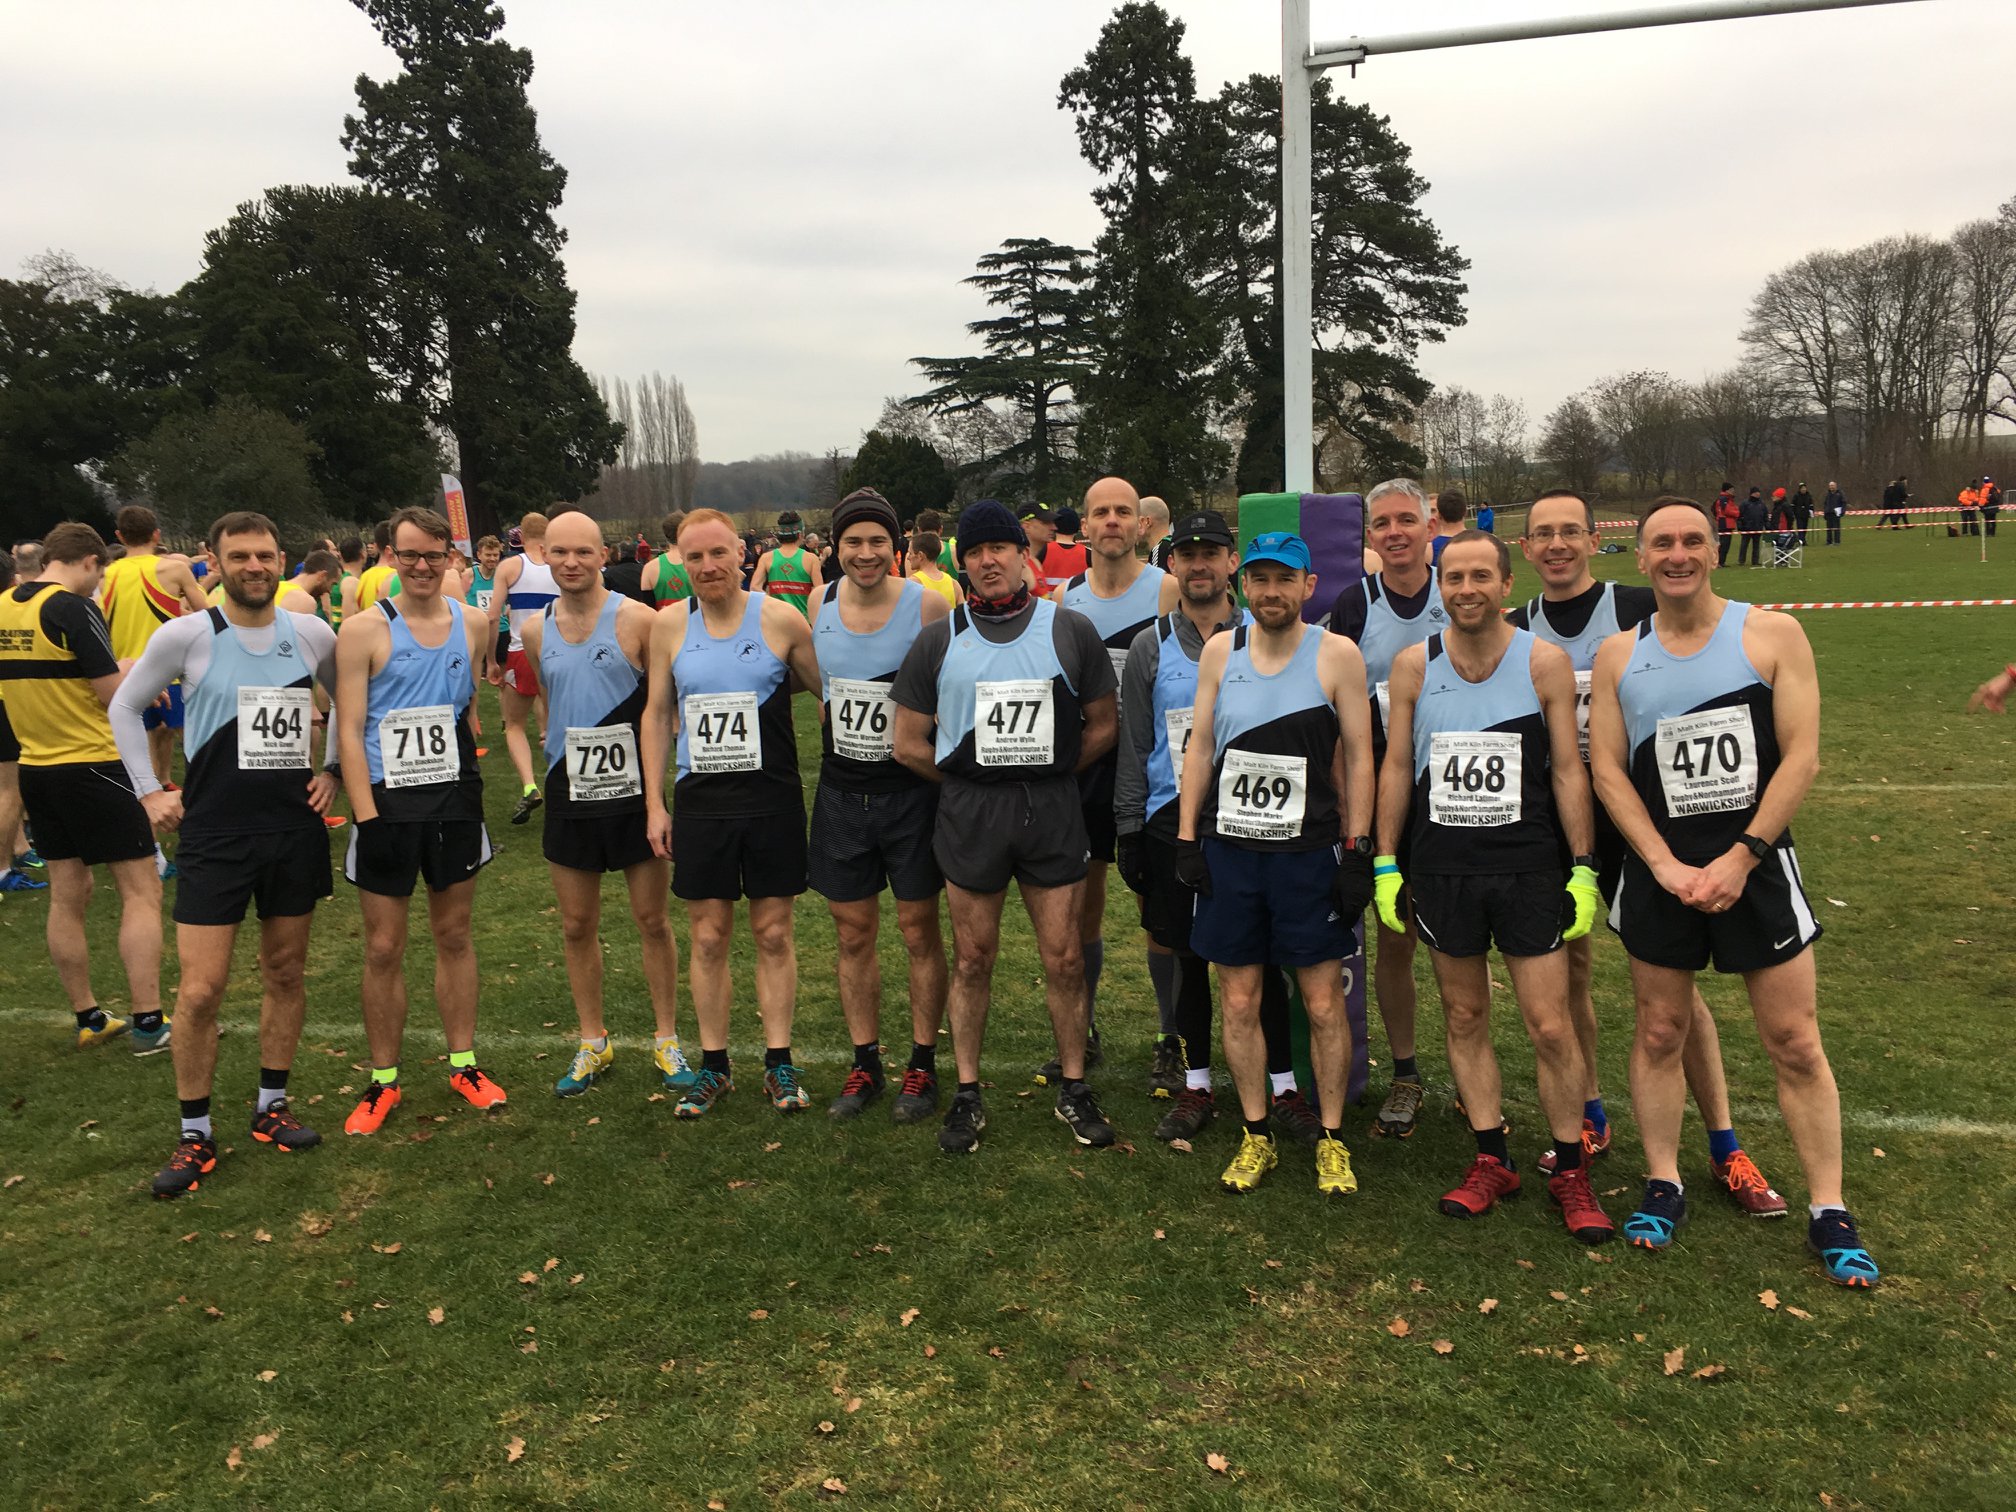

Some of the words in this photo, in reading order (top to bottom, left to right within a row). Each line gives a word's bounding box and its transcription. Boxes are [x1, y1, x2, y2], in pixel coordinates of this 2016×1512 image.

[252, 707, 302, 738] 464
[839, 699, 887, 733] 476
[987, 701, 1041, 734] 477
[698, 712, 747, 744] 474
[1677, 725, 1694, 733] Malt
[393, 725, 446, 758] 718
[577, 743, 625, 774] 720
[838, 746, 894, 760] WARWICKSHIRE
[983, 754, 1048, 764] WARWICKSHIRE
[1673, 733, 1741, 778] 470
[246, 759, 306, 767] WARWICKSHIRE
[696, 761, 756, 771] WARWICKSHIRE
[393, 772, 457, 786] WARWICKSHIRE
[1443, 755, 1505, 792] 468
[1684, 780, 1718, 789] Laurence
[1721, 775, 1740, 784] Scott
[576, 787, 636, 799] WARWICKSHIRE
[1232, 774, 1291, 810] 469
[1675, 794, 1756, 814] WARWICKSHIRE
[1237, 809, 1262, 817] Stephen
[1439, 814, 1513, 824] WARWICKSHIRE
[1224, 824, 1293, 838] WARWICKSHIRE
